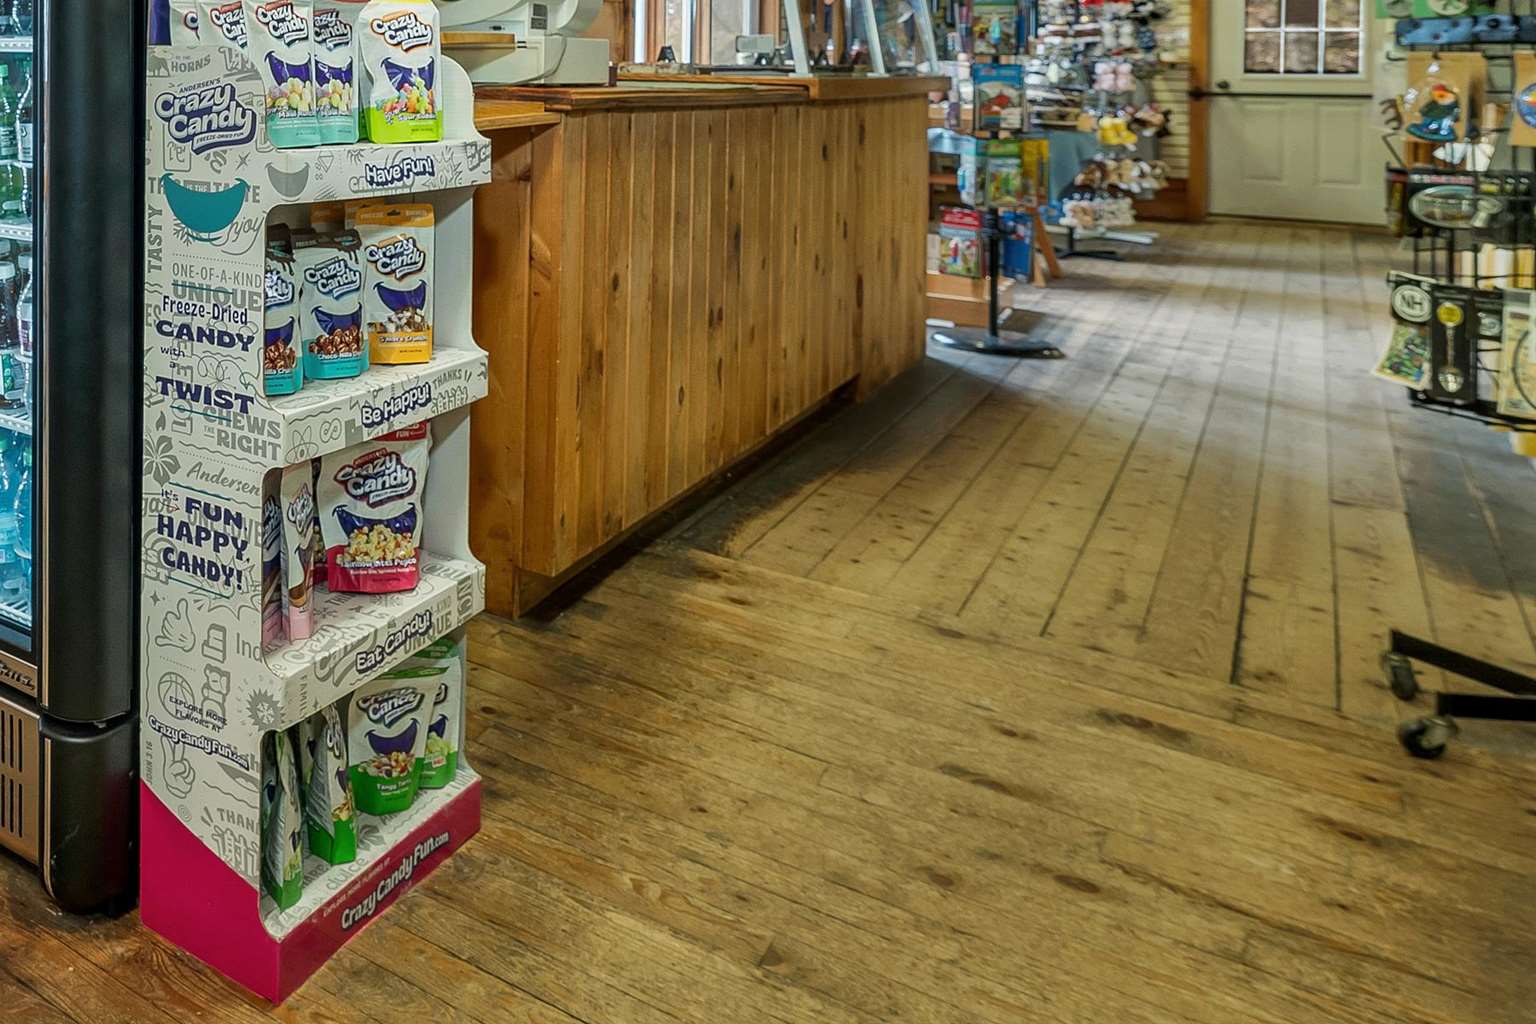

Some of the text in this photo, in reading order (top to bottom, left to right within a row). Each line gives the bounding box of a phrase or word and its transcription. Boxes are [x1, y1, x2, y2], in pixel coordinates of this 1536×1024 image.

[257, 3, 293, 24] Crazy
[269, 13, 308, 36] Candy
[372, 13, 416, 32] Crazy
[385, 23, 432, 45] Candy
[170, 55, 211, 73] HORNS
[155, 84, 233, 119] Crazy
[179, 78, 221, 94] ANDERSEN'S
[168, 100, 254, 137] Candy
[364, 164, 401, 184] Have
[403, 156, 435, 176] Fun!
[147, 204, 163, 274] TASTY
[365, 237, 415, 262] Crazy
[172, 262, 262, 289] ONE-OF-A-KIND
[305, 259, 346, 282] Crazy
[376, 250, 425, 274] Candy
[172, 279, 262, 312] UNIQUE
[317, 269, 360, 294] Candy
[162, 295, 248, 326] Freeze-Dried
[155, 319, 255, 353] CANDY
[160, 346, 185, 357] with
[155, 375, 255, 415] TWIST
[361, 383, 431, 426] Be Happy!
[203, 406, 282, 440] CHEWS
[216, 429, 282, 461] RIGHT
[186, 461, 261, 497] Andersen
[336, 454, 398, 482] Crazy
[347, 466, 415, 497] Candy
[162, 546, 243, 591] CANDY!
[356, 610, 433, 674] Eat Candy!
[147, 715, 250, 772] CrazyCandyFun.com
[340, 830, 451, 930] CrazyCandyFun.com
